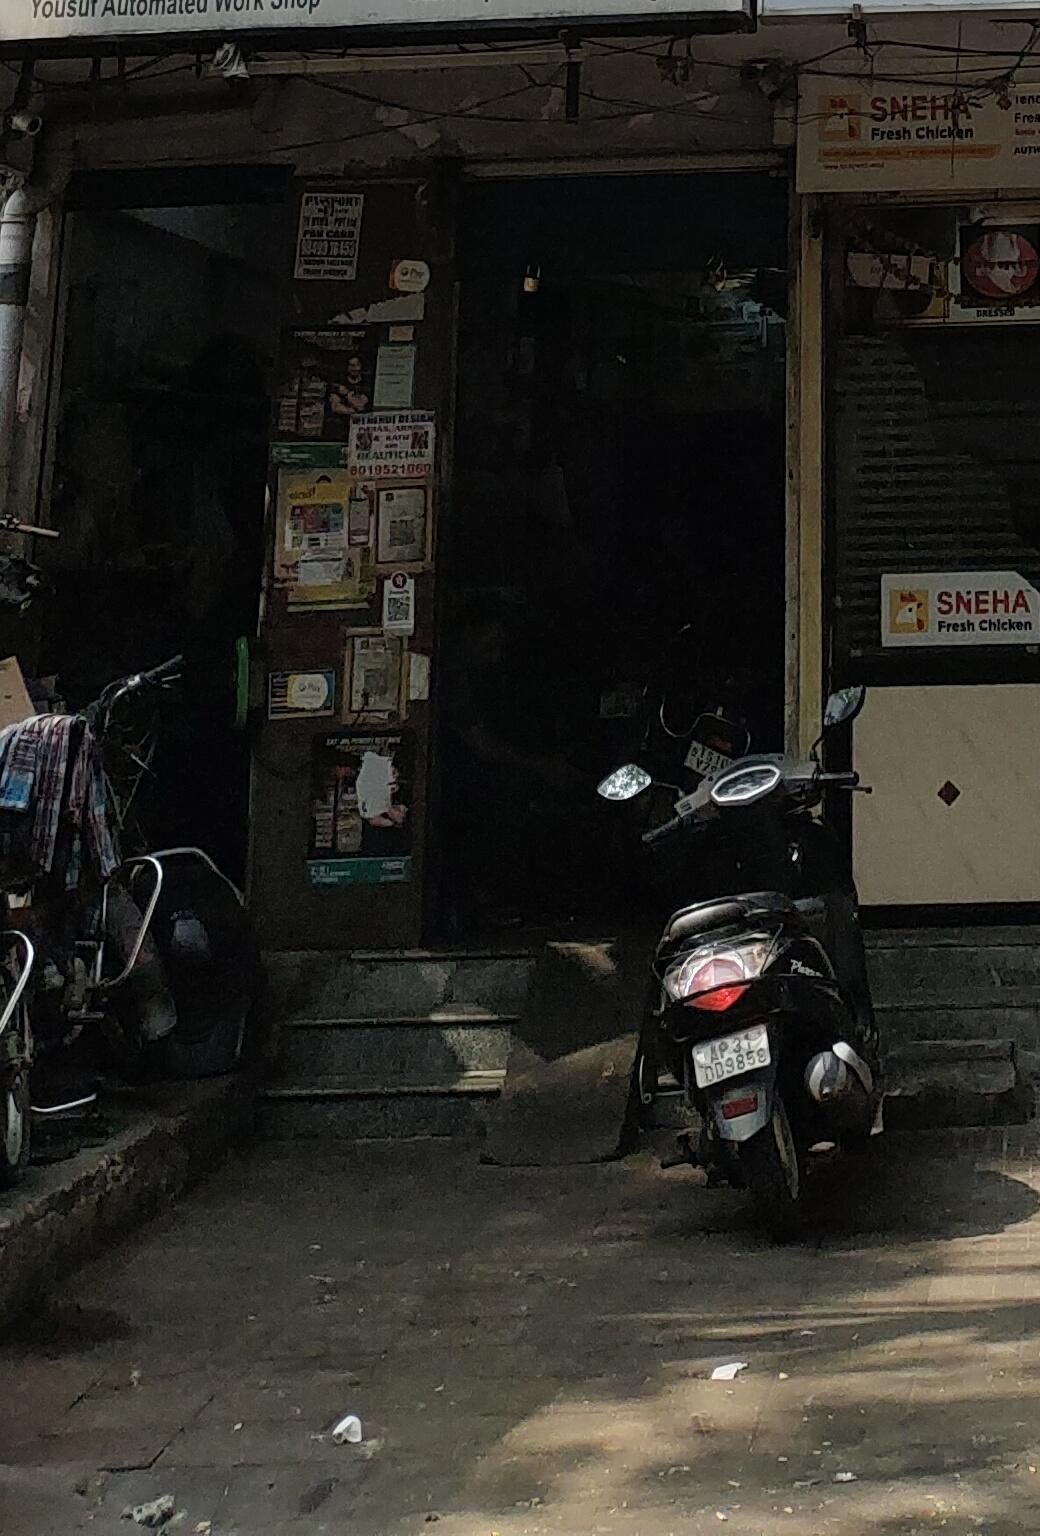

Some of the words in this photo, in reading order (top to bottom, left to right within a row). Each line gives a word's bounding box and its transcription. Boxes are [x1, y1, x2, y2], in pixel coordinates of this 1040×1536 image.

[870, 94, 973, 122] SNEHA
[871, 126, 912, 141] Fresh
[915, 125, 974, 140] Chicken
[937, 589, 1031, 615] SNEHA
[937, 619, 975, 633] Fresh
[979, 618, 1033, 632] Chicken
